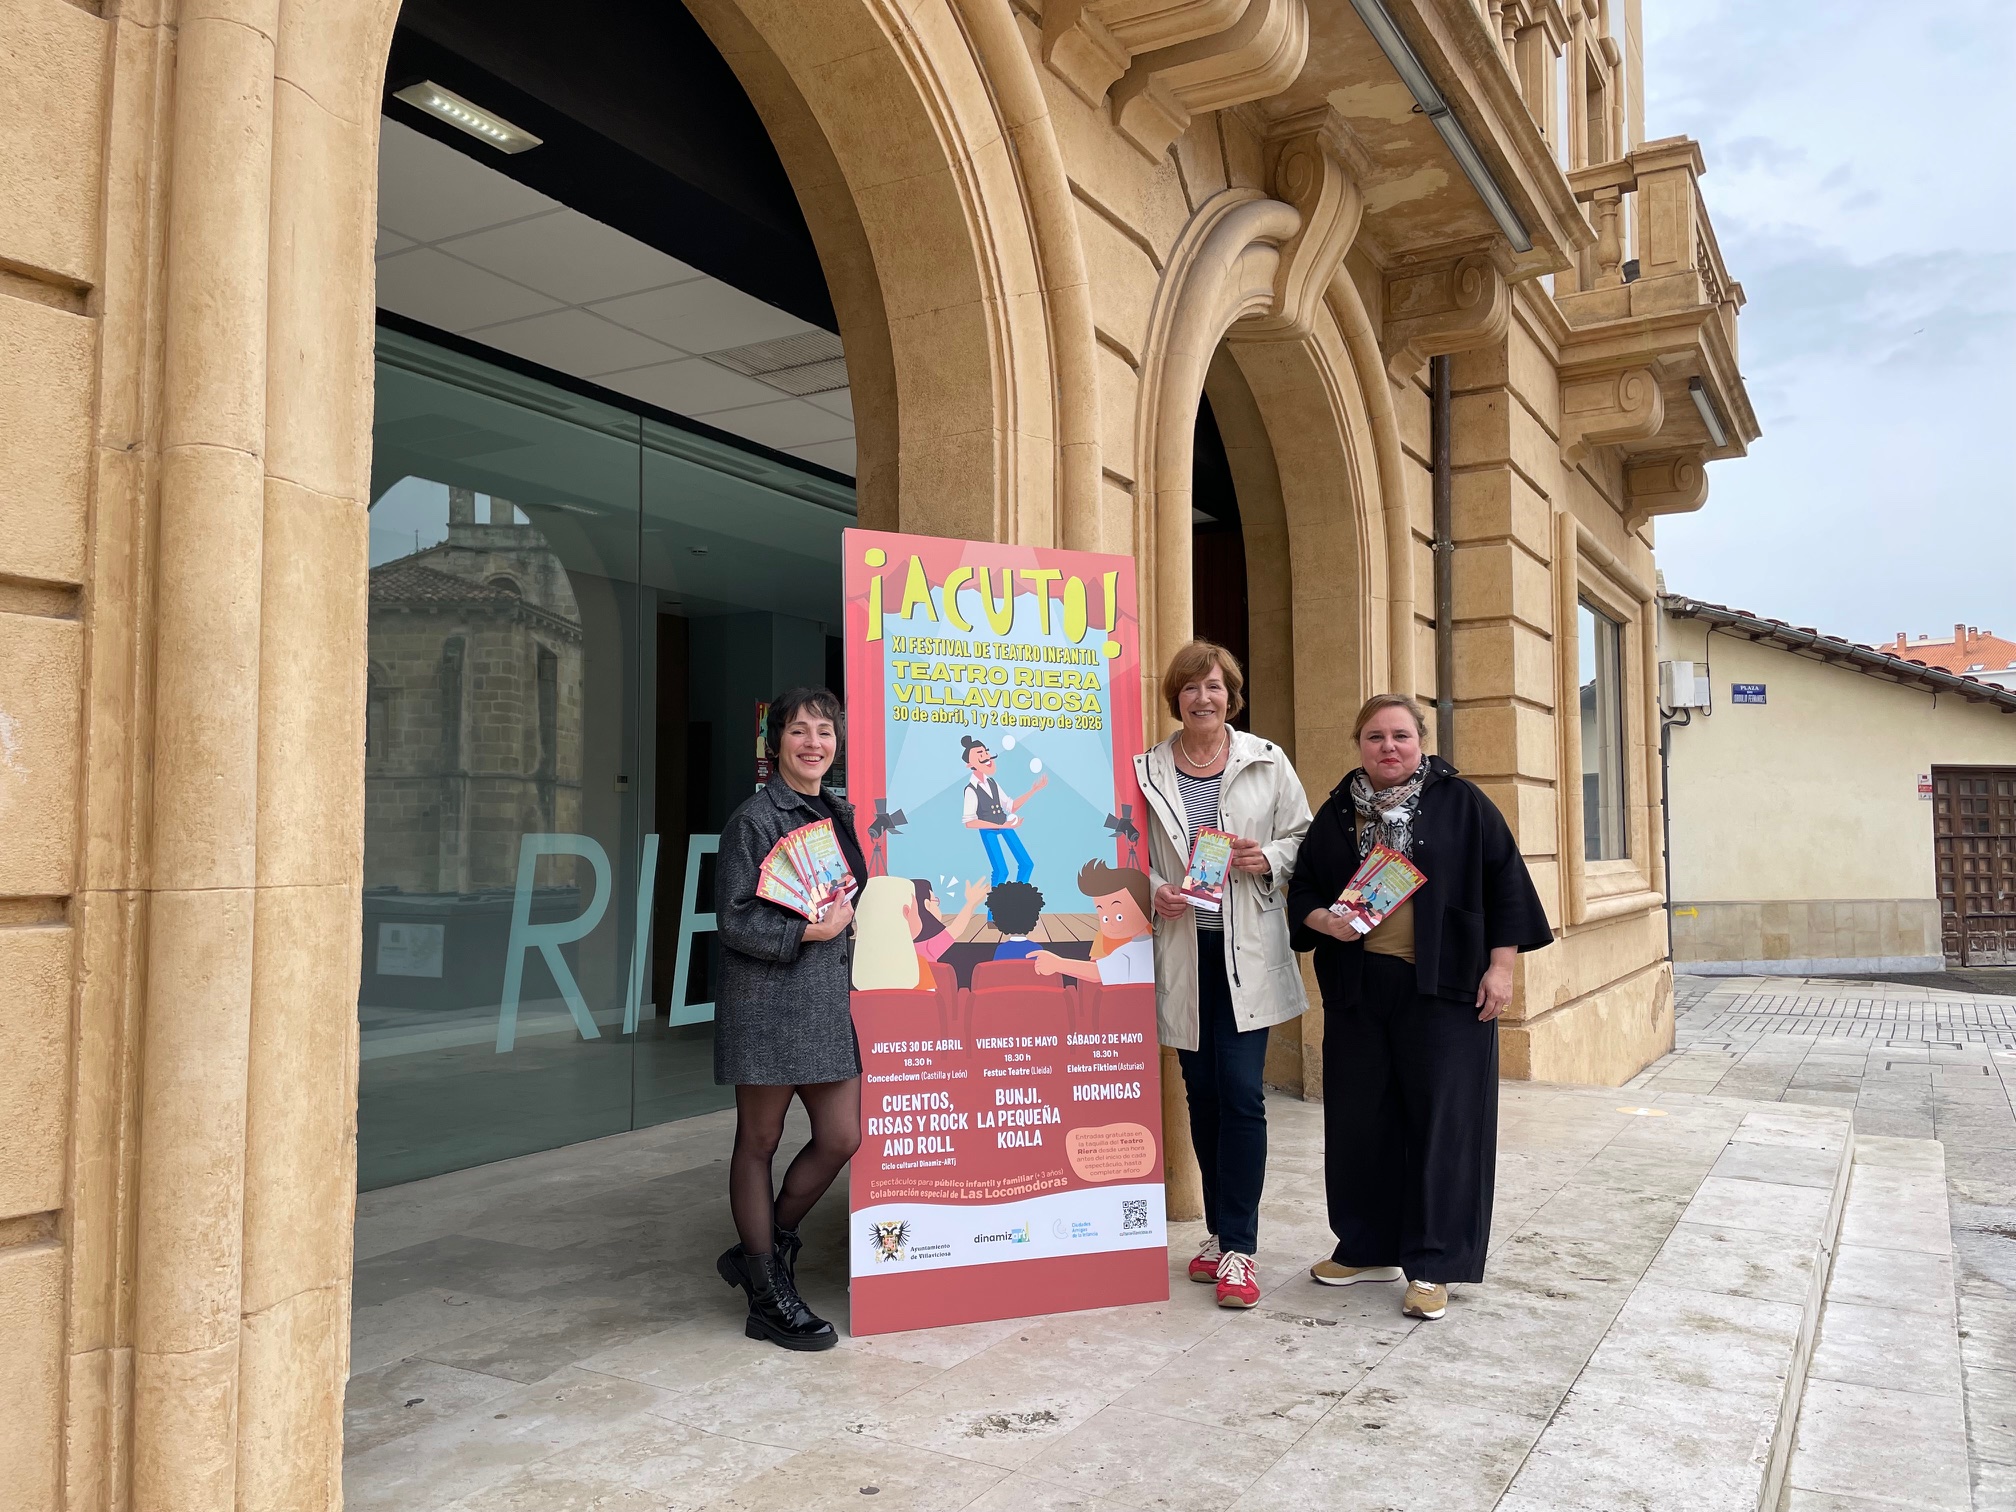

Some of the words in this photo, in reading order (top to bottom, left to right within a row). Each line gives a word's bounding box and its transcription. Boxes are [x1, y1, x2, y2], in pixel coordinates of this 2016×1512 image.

[864, 548, 1121, 659] ¡ACUTO!
[892, 636, 906, 652] XI
[909, 637, 970, 657] FESTIVAL
[974, 642, 990, 659] DE
[993, 643, 1040, 662] TEATRO
[1043, 646, 1099, 666] INFANTIL
[892, 661, 1008, 685] TEATRO
[1014, 667, 1101, 691] RIERA
[892, 683, 1102, 714] VILLAVICIOSA
[893, 706, 908, 721] 30
[911, 706, 928, 722] de
[931, 708, 968, 727] abril,
[971, 710, 978, 724] 1
[980, 714, 988, 728] y
[991, 712, 998, 725] 2
[1000, 711, 1016, 726] de
[1019, 716, 1054, 731] mayo
[1057, 714, 1072, 729] de
[1075, 715, 1102, 730] 2026
[872, 1042, 907, 1054] JUEVES
[909, 1041, 920, 1052] 30
[922, 1041, 933, 1051] DE
[936, 1040, 963, 1051] ABRIL
[976, 1037, 1014, 1049] VIERNES
[1016, 1038, 1019, 1047] 1
[1022, 1037, 1033, 1047] DE
[1035, 1036, 1058, 1047] MAYO
[1067, 1032, 1100, 1045] SÁBADO
[1102, 1035, 1106, 1044] 2
[1108, 1034, 1119, 1044] DE
[1121, 1033, 1142, 1043] MAYO
[904, 1058, 925, 1067] 18.30
[926, 1058, 932, 1066] h
[1004, 1054, 1024, 1062] 18.30
[1093, 1050, 1111, 1058] 18.30
[868, 1073, 920, 1083] Concedeclown
[921, 1071, 946, 1081] (Castilla
[947, 1072, 950, 1080] y
[952, 1070, 968, 1079] León)
[984, 1068, 1006, 1077] Festuc
[1008, 1067, 1030, 1076] Teatre
[1031, 1066, 1052, 1075] (Lleida)
[1067, 1064, 1092, 1073] Elektra
[1093, 1063, 1117, 1071] Fiktion
[1118, 1062, 1144, 1071] (Asturias)
[995, 1088, 1042, 1106] BUNJI.
[1073, 1082, 1140, 1101] HORMIGAS
[882, 1092, 954, 1112] CUENTOS,
[868, 1115, 912, 1136] RISAS
[916, 1116, 926, 1132] Y
[930, 1113, 968, 1131] ROCK
[977, 1111, 995, 1128] LA
[998, 1105, 1061, 1127] PEQUEÑA
[883, 1138, 914, 1157] AND
[918, 1136, 954, 1154] ROLL
[997, 1129, 1042, 1149] KOALA
[882, 1162, 896, 1170] Ciclo
[897, 1160, 918, 1169] cultural
[871, 1178, 917, 1188] Espectáculos
[918, 1179, 934, 1187] para
[934, 1178, 964, 1188] público
[966, 1178, 995, 1188] infantil
[996, 1180, 1001, 1188] y
[1003, 1174, 1033, 1185] familiar
[1046, 1168, 1064, 1177] años)
[870, 1188, 919, 1199] Colaboración
[920, 1189, 949, 1199] especial
[950, 1189, 959, 1198] de
[960, 1188, 982, 1199] Las
[985, 1176, 1068, 1198] Locomodoras
[910, 1244, 950, 1252] Ayuntamiento
[919, 1251, 951, 1259] Villaviciosa
